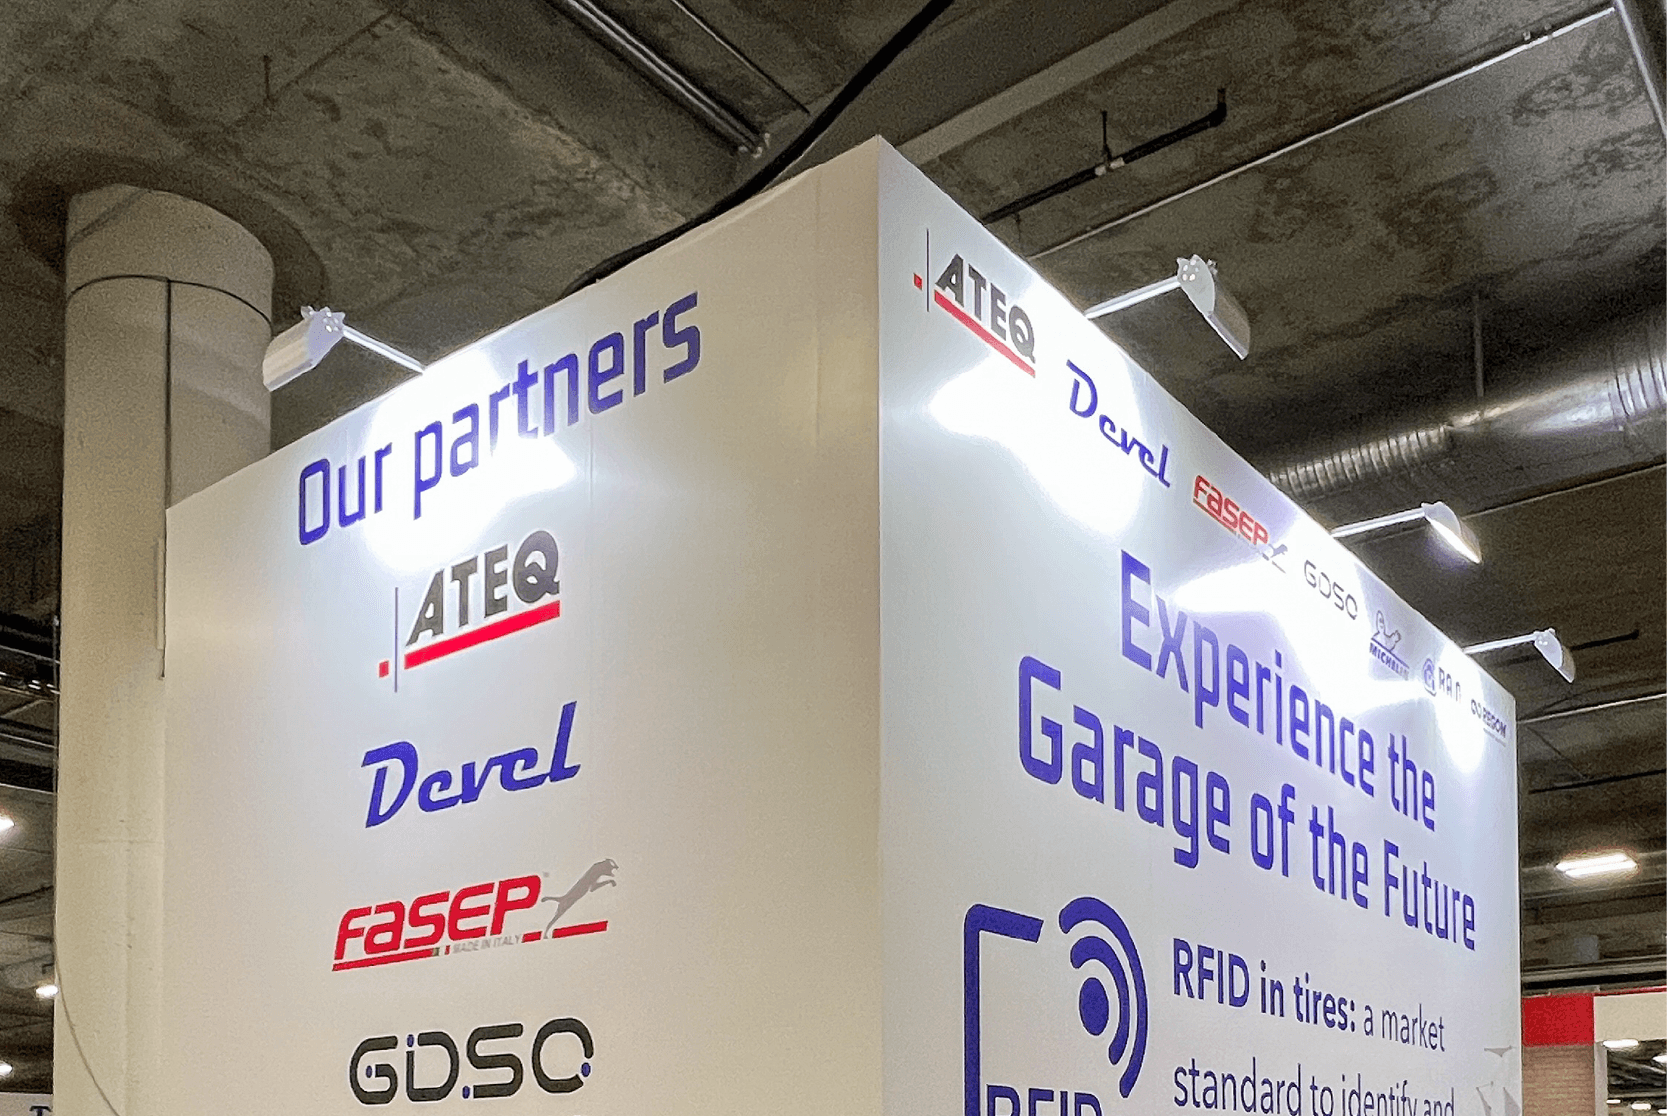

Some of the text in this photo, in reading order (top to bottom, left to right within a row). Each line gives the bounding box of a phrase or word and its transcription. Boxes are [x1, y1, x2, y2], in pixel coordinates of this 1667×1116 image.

[935, 254, 1035, 364] ATEQ
[299, 291, 701, 546] Our partners
[1066, 359, 1170, 488] Devel
[405, 529, 561, 647] ATEQ
[1121, 549, 1435, 832] Experience the
[361, 701, 581, 828] Devel
[1018, 655, 1476, 951] Garage of the Future
[1173, 937, 1445, 1052] RFID in tires: a market
[349, 1017, 594, 1105] GDSO
[1173, 1056, 1302, 1116] standard
